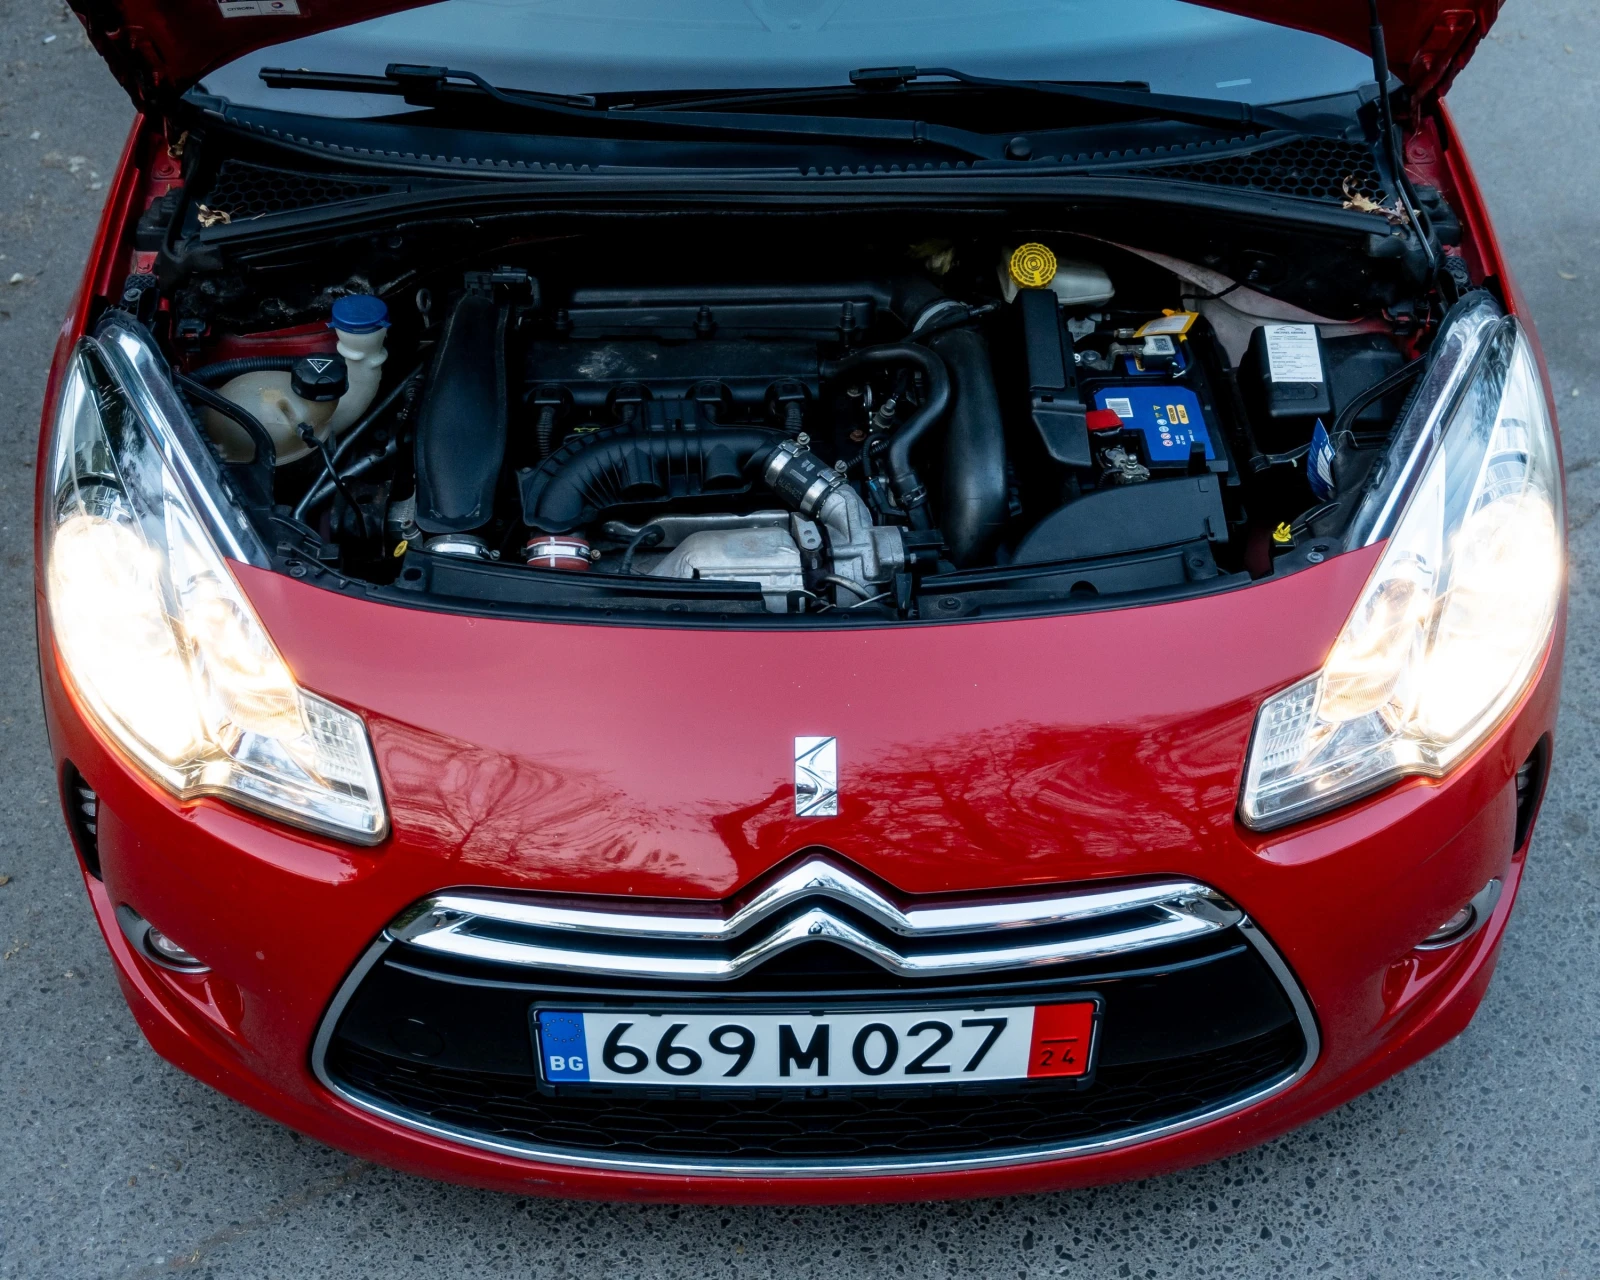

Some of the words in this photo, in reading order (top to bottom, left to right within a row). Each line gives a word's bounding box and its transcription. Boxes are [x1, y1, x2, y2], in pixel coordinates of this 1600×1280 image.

[602, 1022, 756, 1077] 669
[778, 1024, 830, 1077] M
[852, 1017, 1008, 1076] 027
[550, 1056, 584, 1071] BG
[1040, 1050, 1076, 1066] 24
